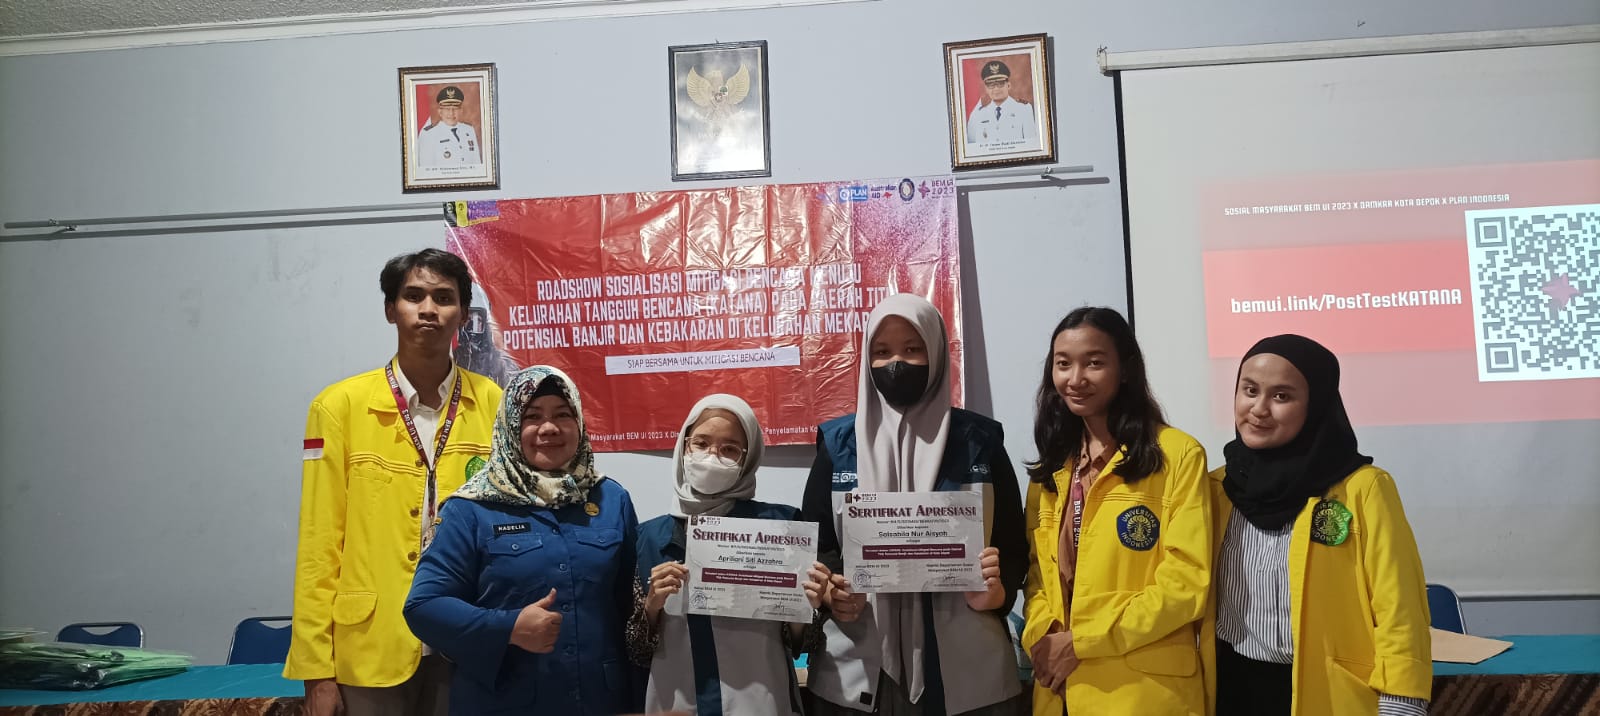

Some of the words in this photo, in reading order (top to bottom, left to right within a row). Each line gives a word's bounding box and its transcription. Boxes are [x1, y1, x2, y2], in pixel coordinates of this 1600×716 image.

[1224, 207, 1250, 216] SOSIAL
[1252, 204, 1302, 215] MASYARAKAT
[1304, 202, 1321, 212] BEM
[1322, 202, 1330, 211] UI
[1332, 202, 1351, 210] 2023
[1353, 201, 1358, 209] X
[1360, 199, 1393, 209] DAMKAR
[1394, 198, 1414, 207] KOTA
[1415, 197, 1440, 206] DEPOK
[1442, 197, 1447, 205] X
[1449, 195, 1468, 204] PLAN
[1469, 193, 1510, 203] INDONESIA
[537, 276, 602, 301] ROADSHOW
[606, 272, 682, 297] SOSIALISASI
[686, 269, 743, 292] MITIGASI
[509, 302, 581, 327] KELURAHAN
[584, 299, 639, 323] TANGGUH
[643, 296, 699, 319] BENCANA
[707, 292, 767, 317] (KATANA)
[1231, 288, 1462, 313] bemui.link/PostTestKATANA
[504, 327, 569, 350] POTENSIAL
[572, 324, 616, 347] BANJIR
[620, 323, 644, 345] DAN
[648, 319, 724, 343] KEBAKARAN
[728, 317, 740, 339] DI
[744, 313, 821, 338] KELURAHAN
[627, 359, 644, 369] SIAP
[645, 357, 679, 368] BERSAMA
[680, 355, 703, 367] UNTUK
[705, 353, 739, 365] MITIGASI
[740, 351, 776, 363] BENCANA
[590, 433, 625, 442] Masyarakat
[640, 431, 647, 439] UI
[648, 431, 663, 439] 2023
[664, 431, 669, 439] X
[764, 425, 809, 436] Penyelamatan
[848, 506, 912, 518] SERTIFIKAT
[916, 505, 976, 518] APRESIASI
[1073, 500, 1081, 515] BEM
[1073, 516, 1080, 525] UI
[692, 528, 752, 543] SERTIFIKAT
[755, 531, 812, 547] APRESIASI
